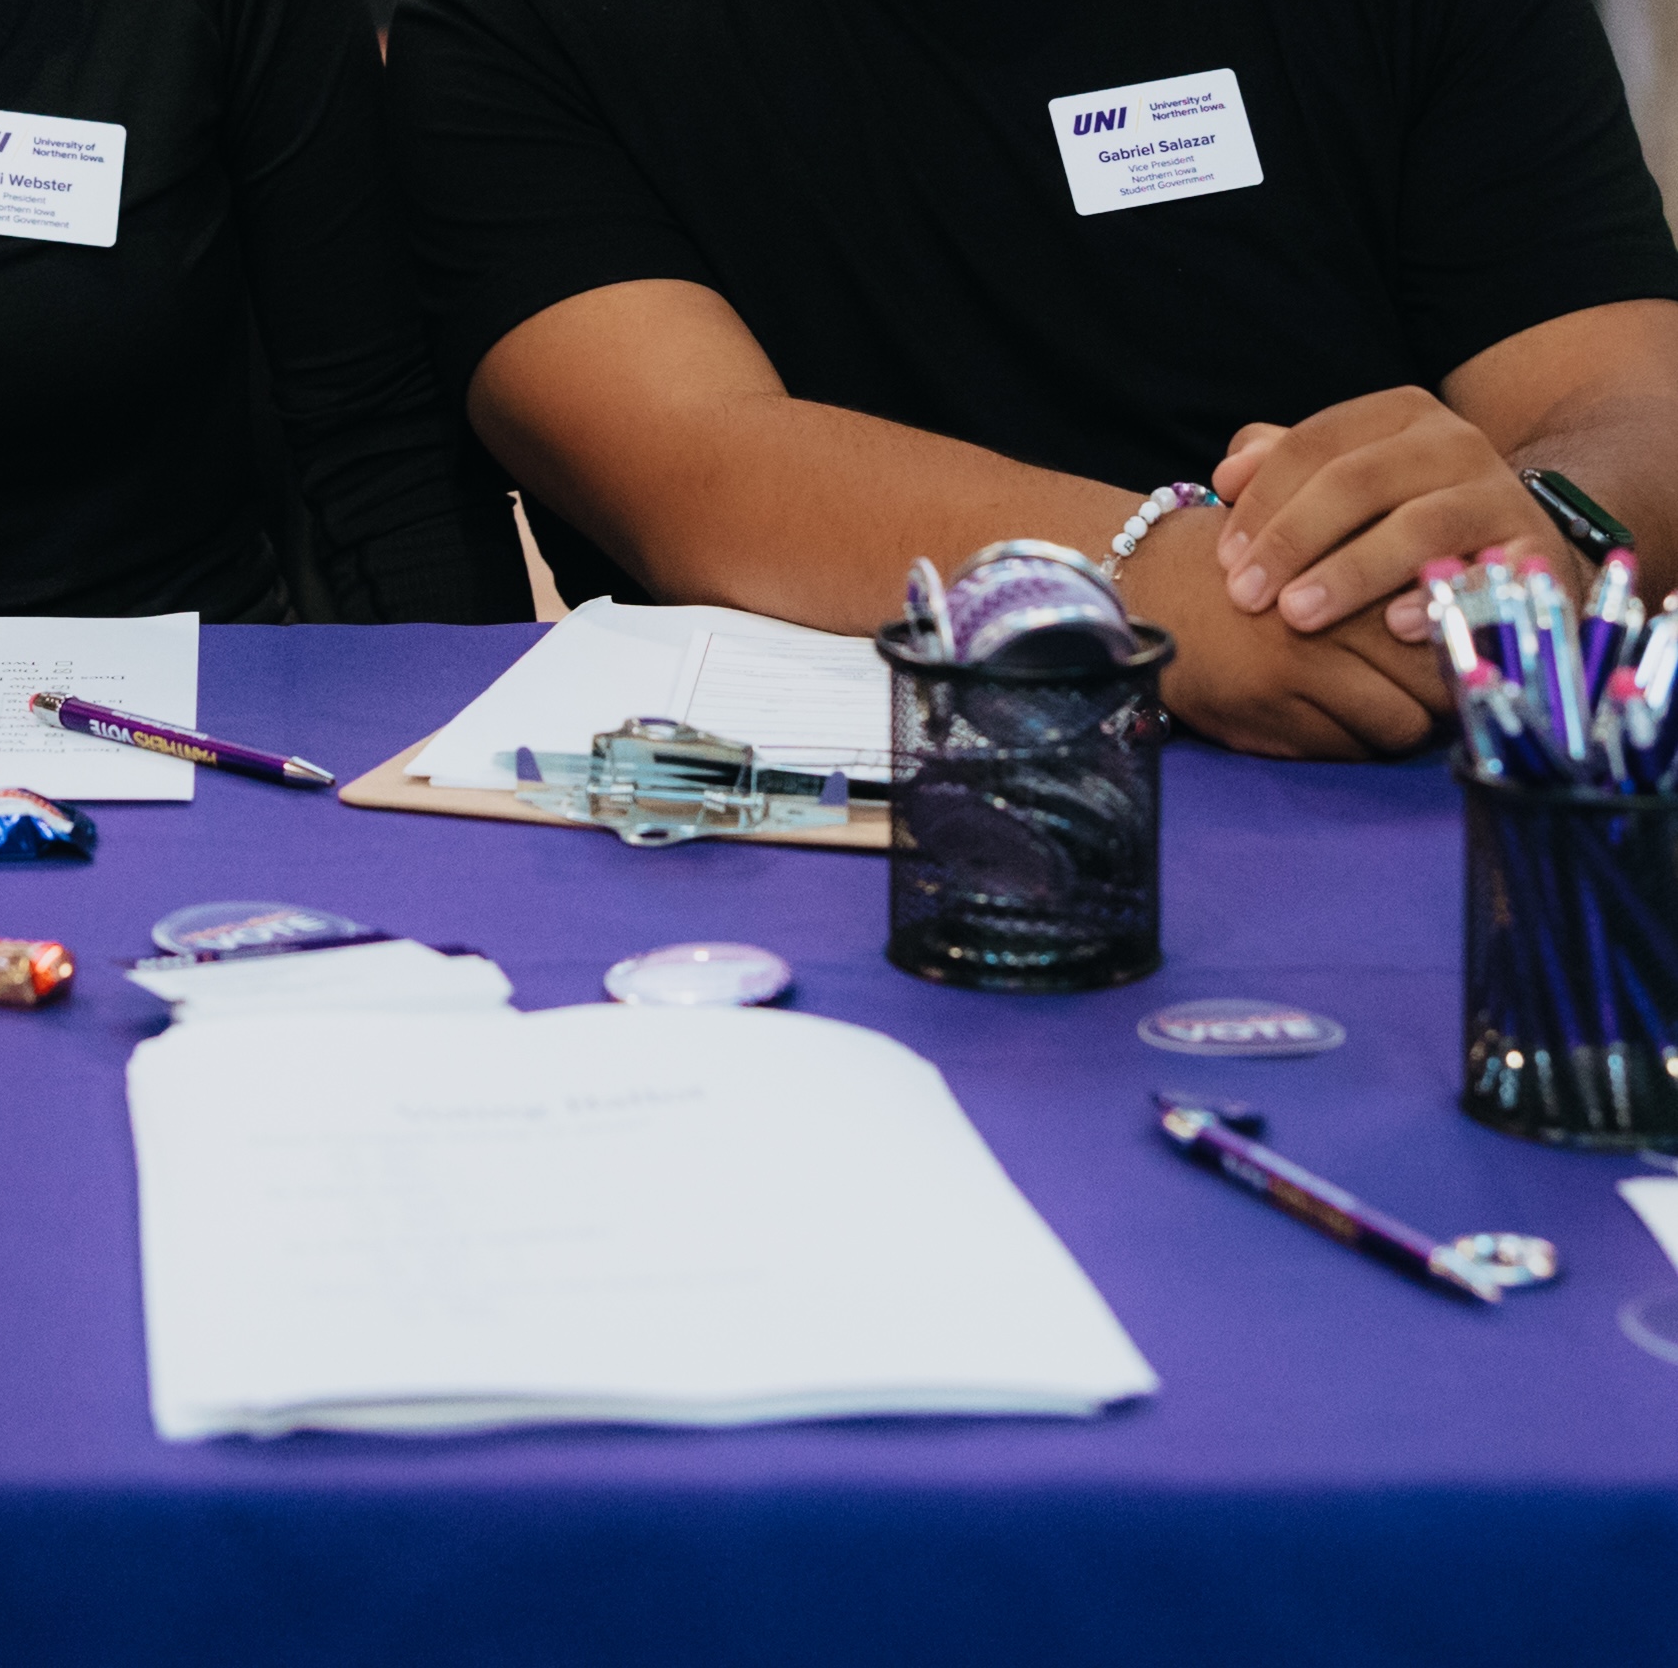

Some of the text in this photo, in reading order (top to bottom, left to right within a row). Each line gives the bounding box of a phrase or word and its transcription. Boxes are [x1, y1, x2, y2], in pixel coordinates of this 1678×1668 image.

[1149, 93, 1211, 111] University of
[1073, 107, 1127, 136] UNI
[1152, 108, 1198, 121] Northern
[34, 137, 96, 151] University of
[1098, 134, 1216, 163] Gabriel Salazar
[33, 148, 77, 159] Northern
[1128, 155, 1194, 173] Vice President
[9, 174, 72, 192] Webster
[1132, 167, 1197, 183] Northern Iowa
[1120, 173, 1214, 196] Student Government
[3, 192, 46, 204] President
[34, 207, 55, 217] Iowa
[13, 214, 70, 228] Government
[88, 718, 134, 745] VOTE
